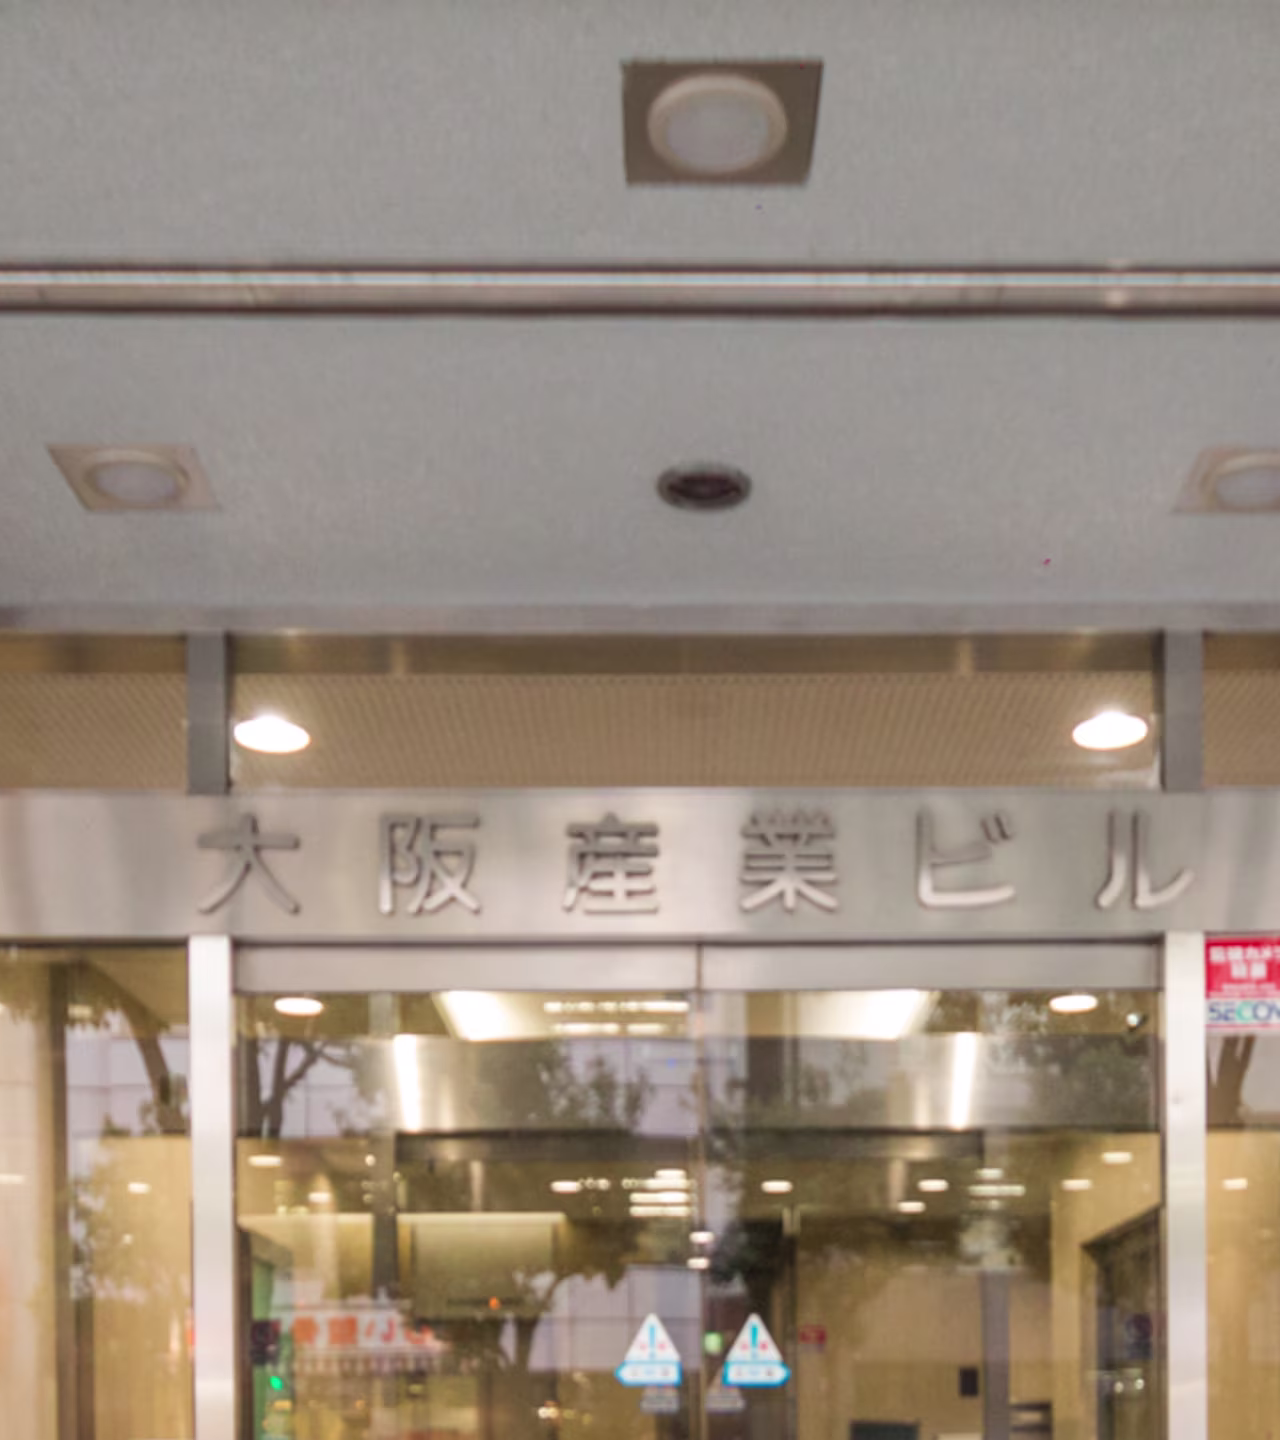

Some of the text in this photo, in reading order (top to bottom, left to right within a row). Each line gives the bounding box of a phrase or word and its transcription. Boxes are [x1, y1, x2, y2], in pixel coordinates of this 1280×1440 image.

[196, 809, 1197, 916] 大阪産業ビル
